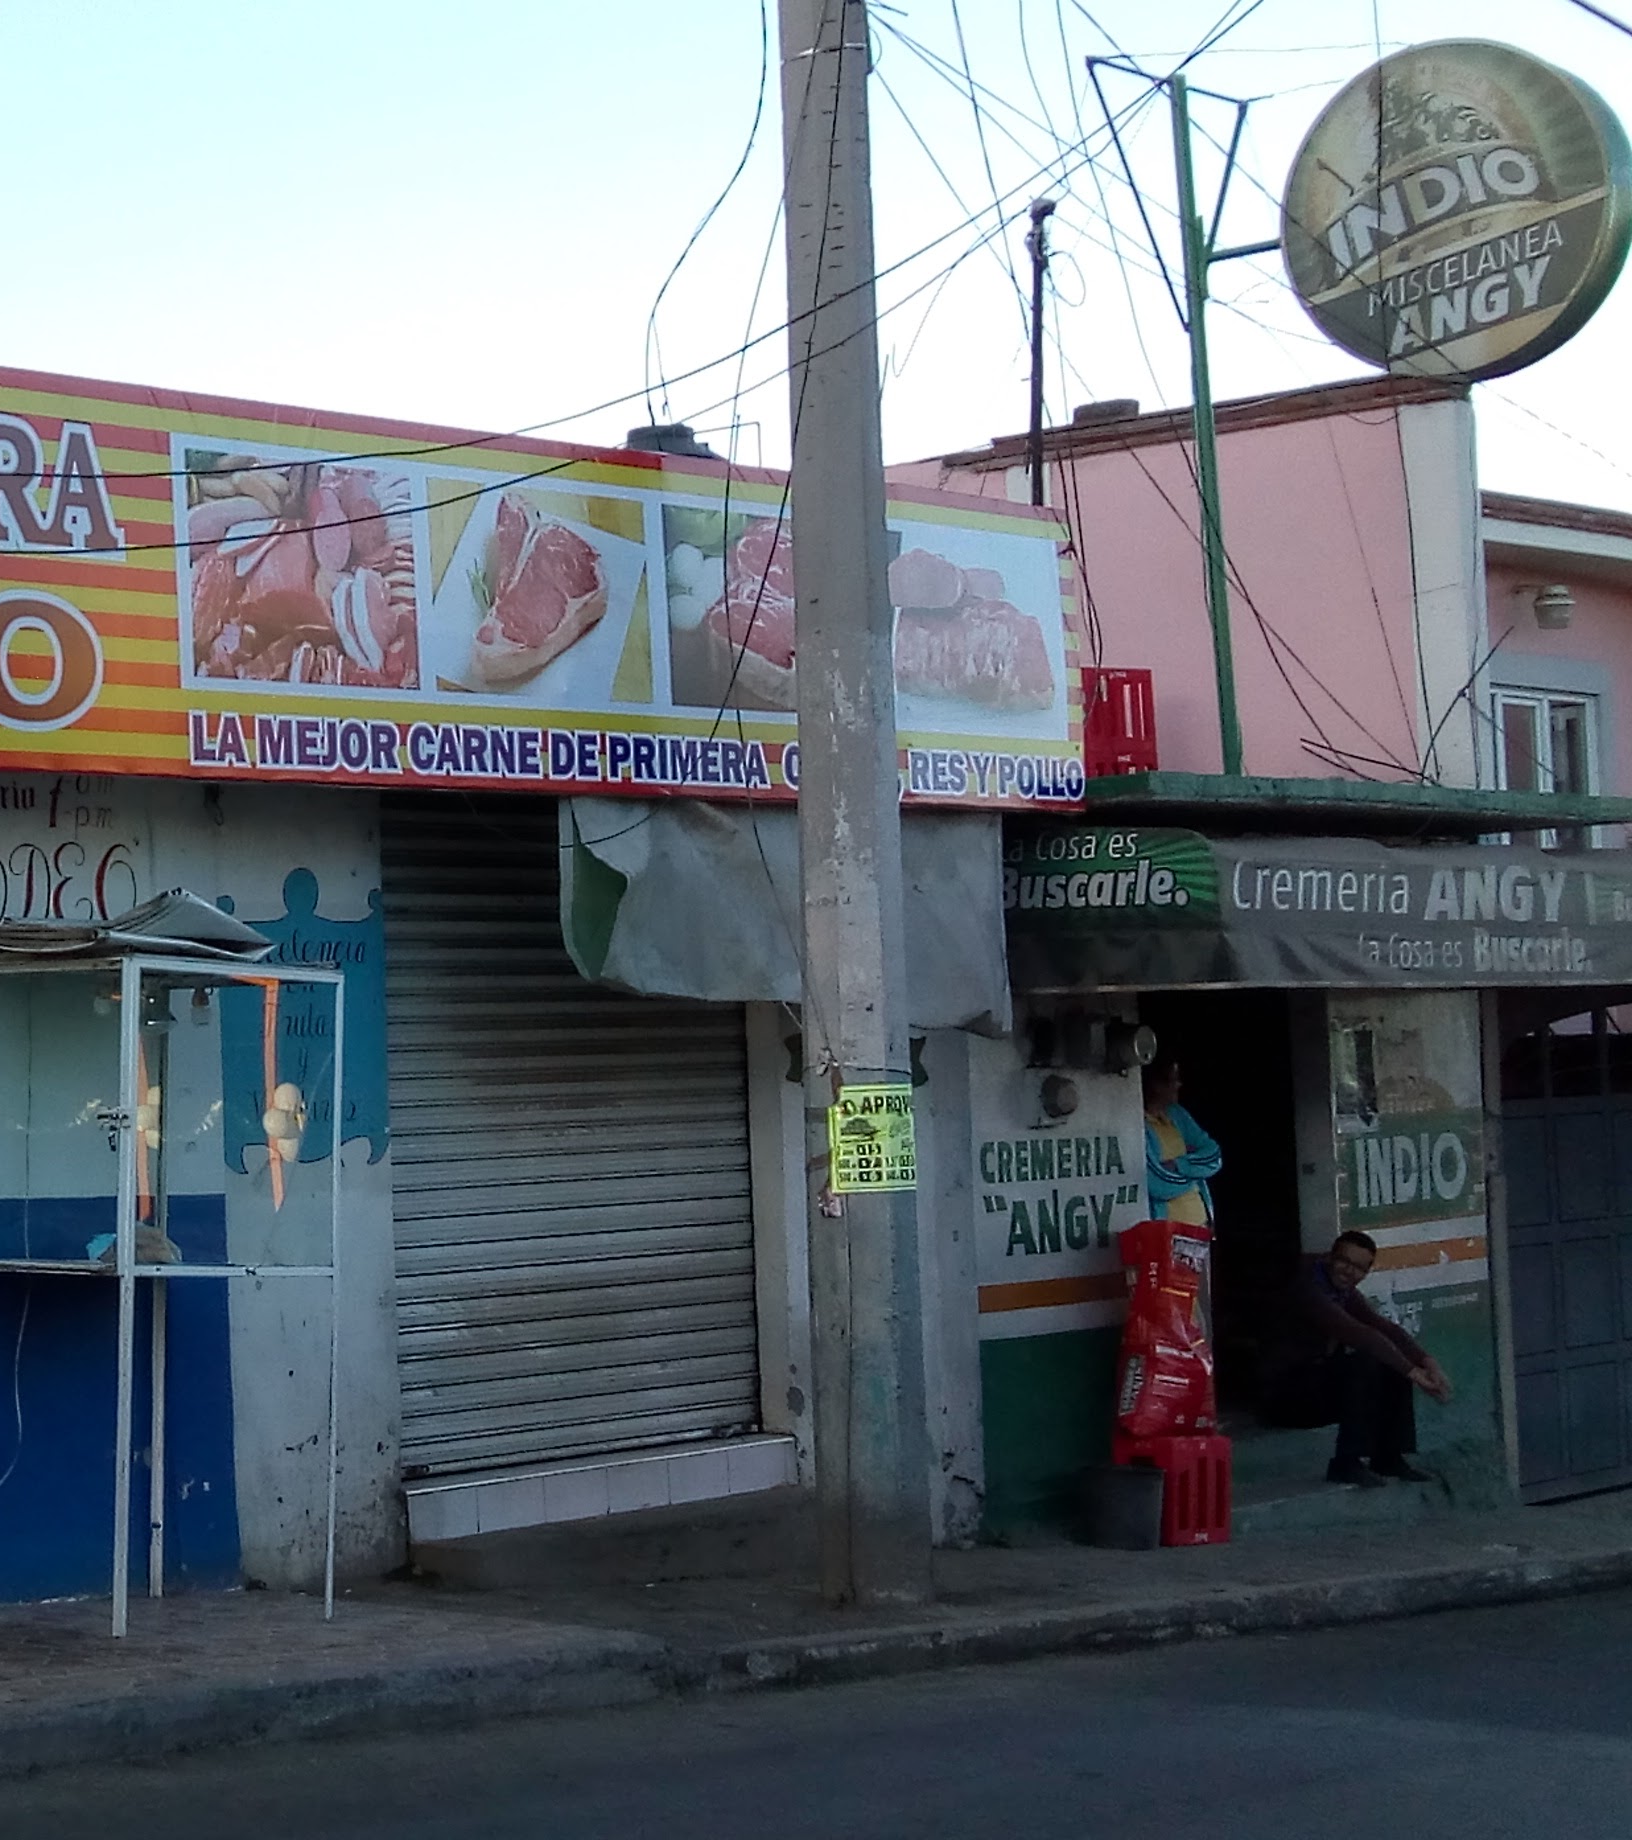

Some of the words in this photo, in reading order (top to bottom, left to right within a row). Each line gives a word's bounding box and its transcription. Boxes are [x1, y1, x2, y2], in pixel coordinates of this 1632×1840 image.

[1327, 147, 1540, 281] INDIO
[1369, 220, 1564, 317] MISCELANEA
[1388, 255, 1552, 356] ANGY
[188, 709, 252, 768] LA
[255, 713, 403, 774] MEJOR
[407, 722, 544, 780] CARNE
[548, 728, 602, 782] DE
[606, 731, 772, 790] PRIMERA
[908, 748, 967, 796] RES
[968, 751, 995, 798] Y
[994, 755, 1087, 803] POLLO
[1036, 831, 1097, 860] Cosa
[1108, 831, 1139, 858] es
[1003, 858, 1190, 911] Buscarle.
[1233, 859, 1410, 914] Cremeria
[1424, 865, 1567, 922] ANGY
[1389, 931, 1435, 969] Cosa
[1442, 939, 1463, 969] es
[980, 1136, 1125, 1183] CREMERIA
[1355, 1132, 1468, 1208] INDIO
